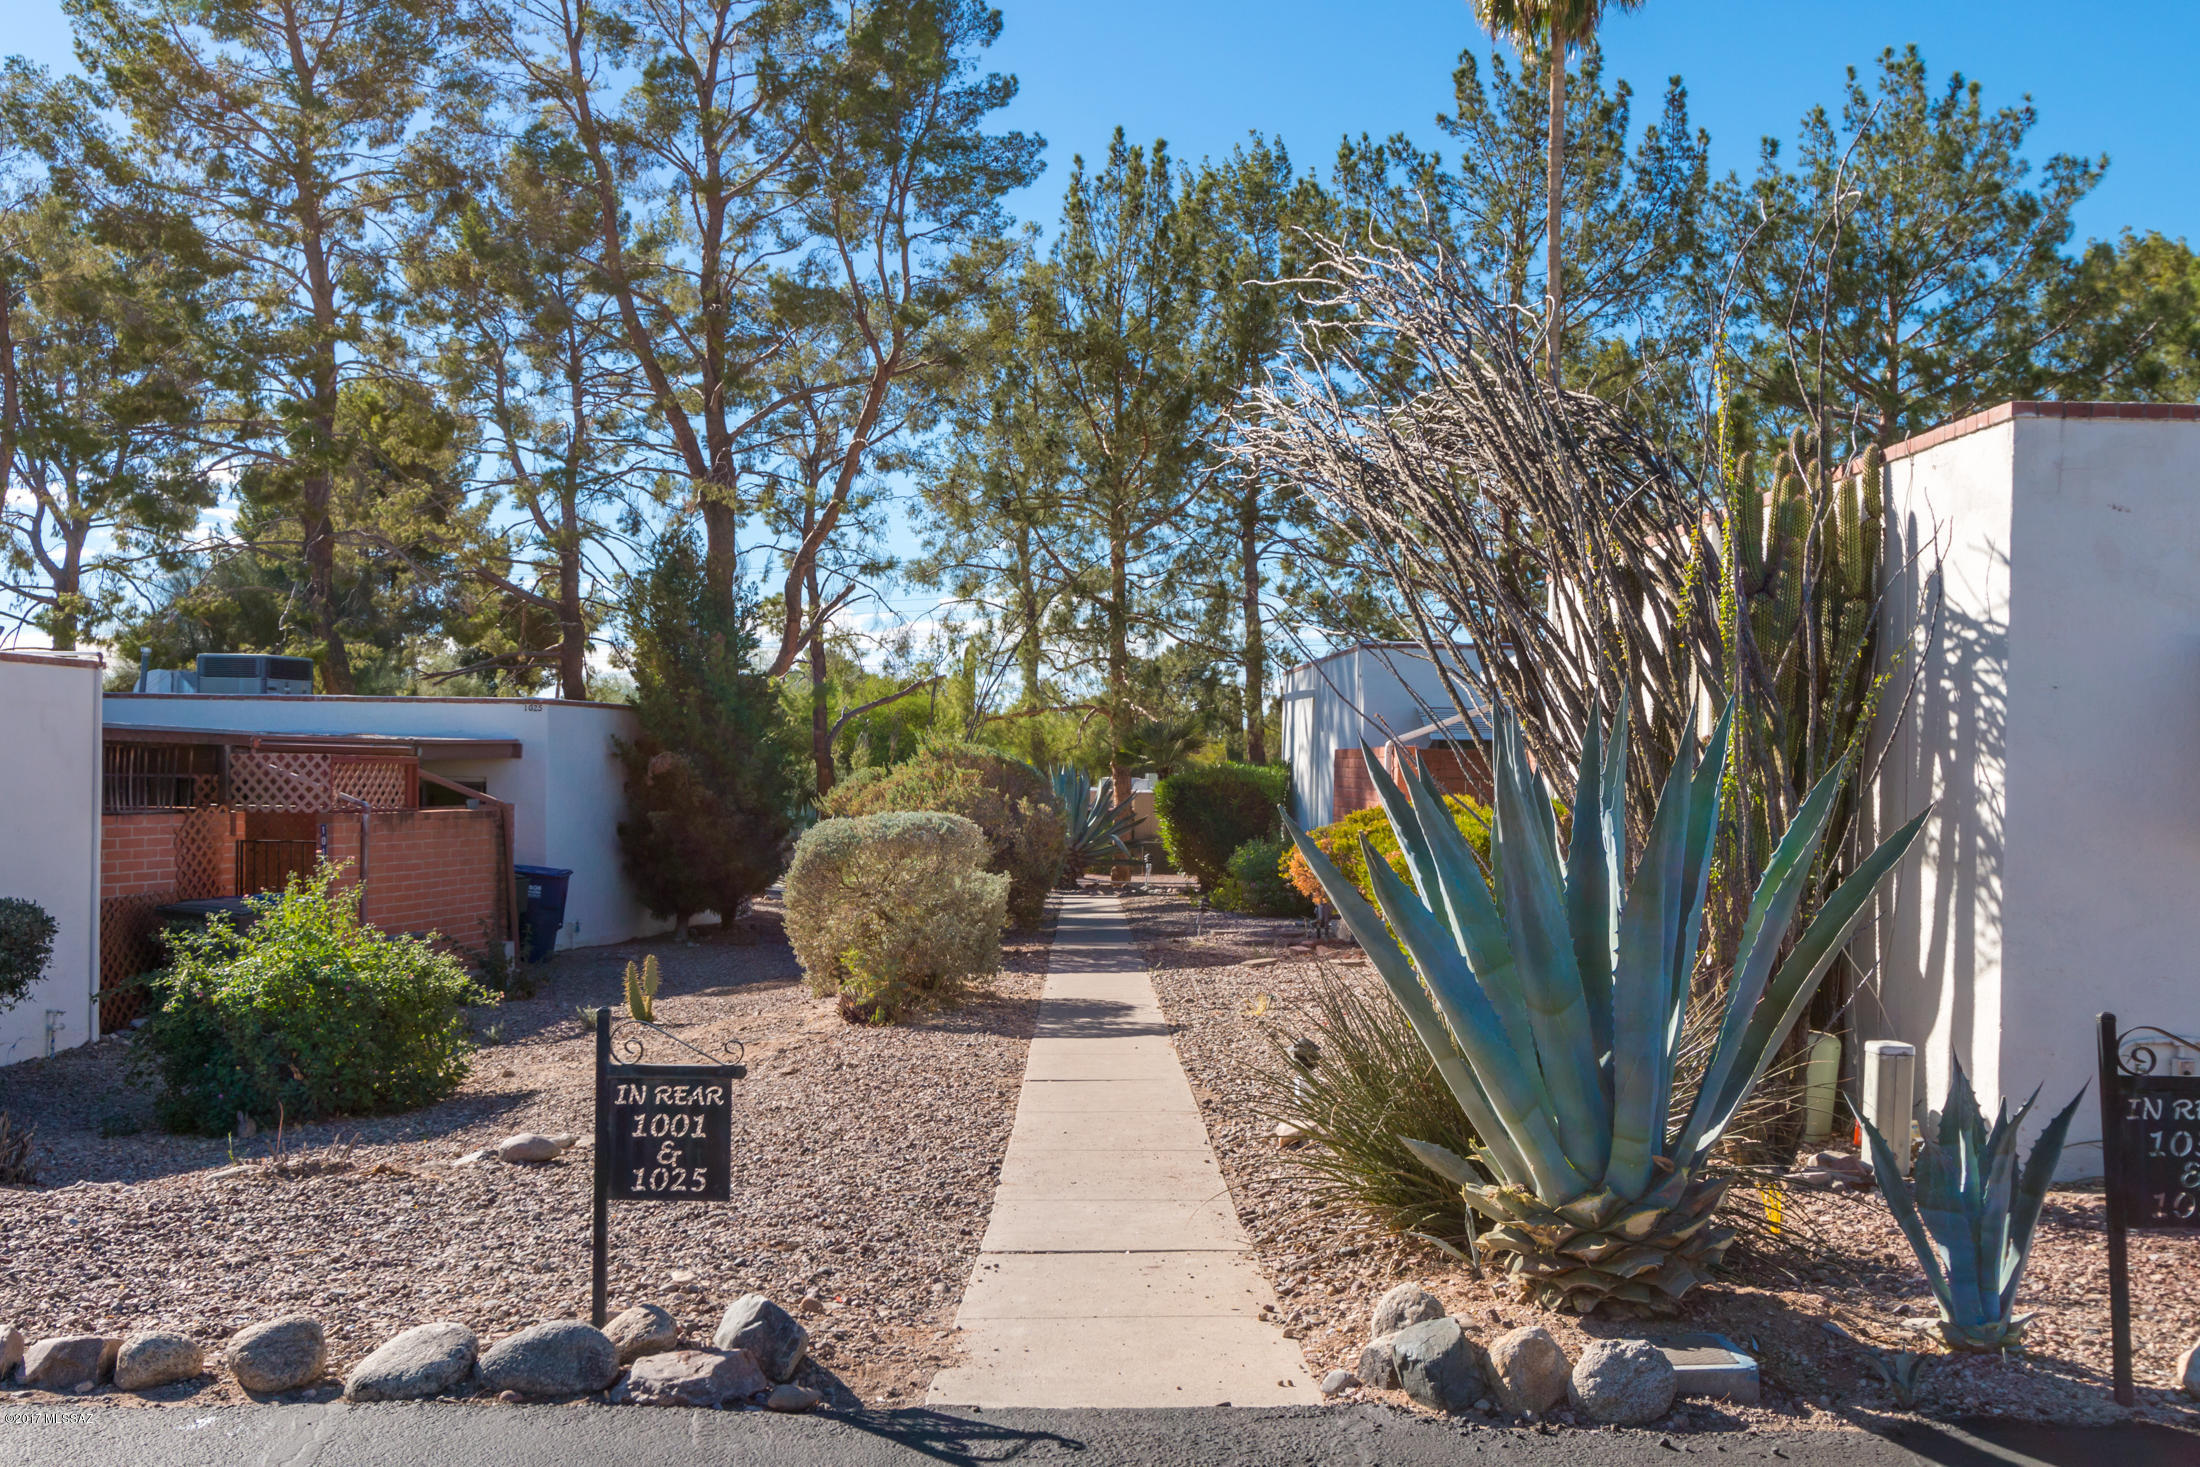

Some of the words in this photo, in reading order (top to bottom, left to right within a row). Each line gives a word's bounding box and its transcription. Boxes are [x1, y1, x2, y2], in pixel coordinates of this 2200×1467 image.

[523, 704, 543, 712] 1025
[614, 1083, 647, 1105] IN
[654, 1085, 724, 1106] REAR
[2126, 1097, 2163, 1120] IN
[631, 1113, 707, 1138] 1001
[656, 1140, 682, 1167] &
[2149, 1130, 2200, 1157] 10
[631, 1168, 708, 1192] 1025
